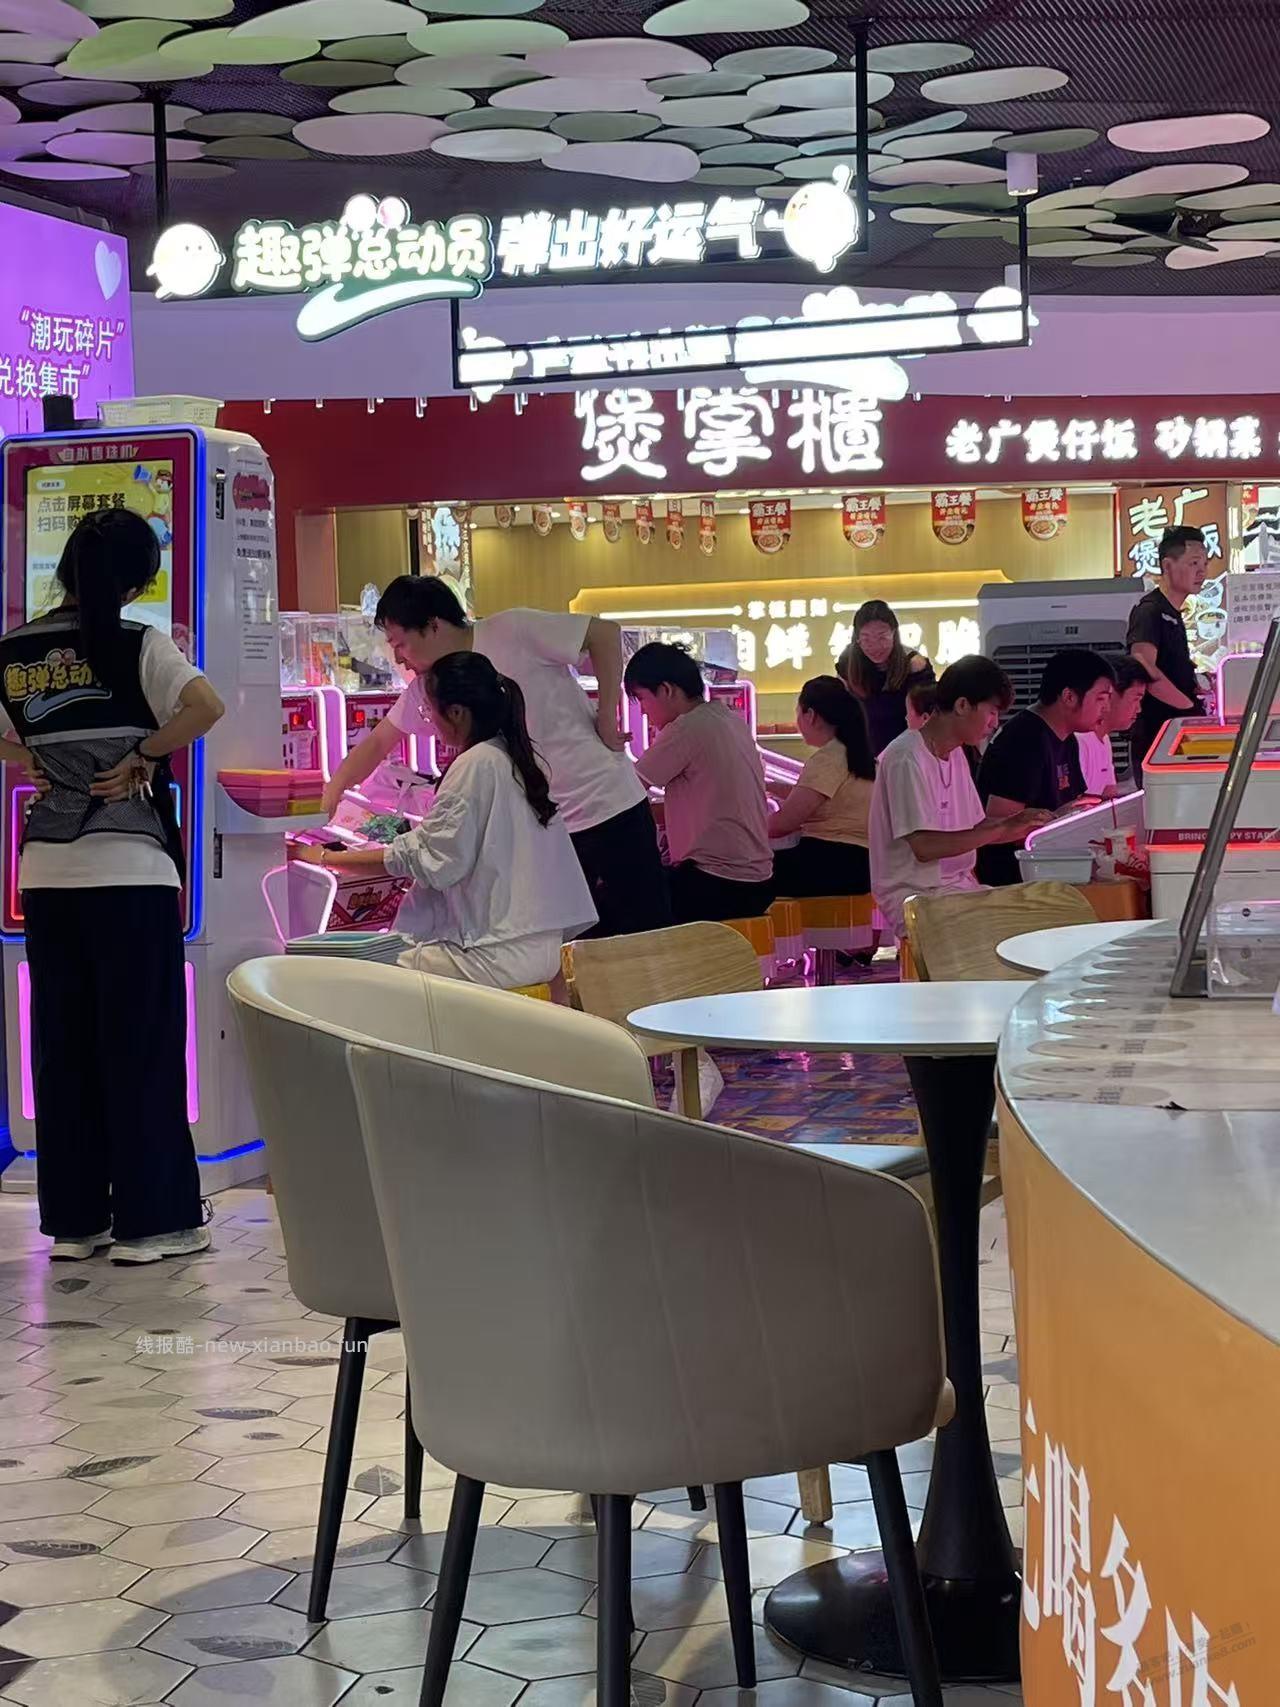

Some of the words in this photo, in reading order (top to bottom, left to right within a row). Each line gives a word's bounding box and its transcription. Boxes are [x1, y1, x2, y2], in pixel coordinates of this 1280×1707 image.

[236, 218, 486, 287] 趣弹总动员
[498, 197, 765, 276] 弹出好运气
[946, 418, 1138, 463] 老广煲仔饭
[1155, 416, 1262, 460] 砂锅菜
[1128, 488, 1209, 538] 老广
[6, 661, 95, 698] 趣弹总动
